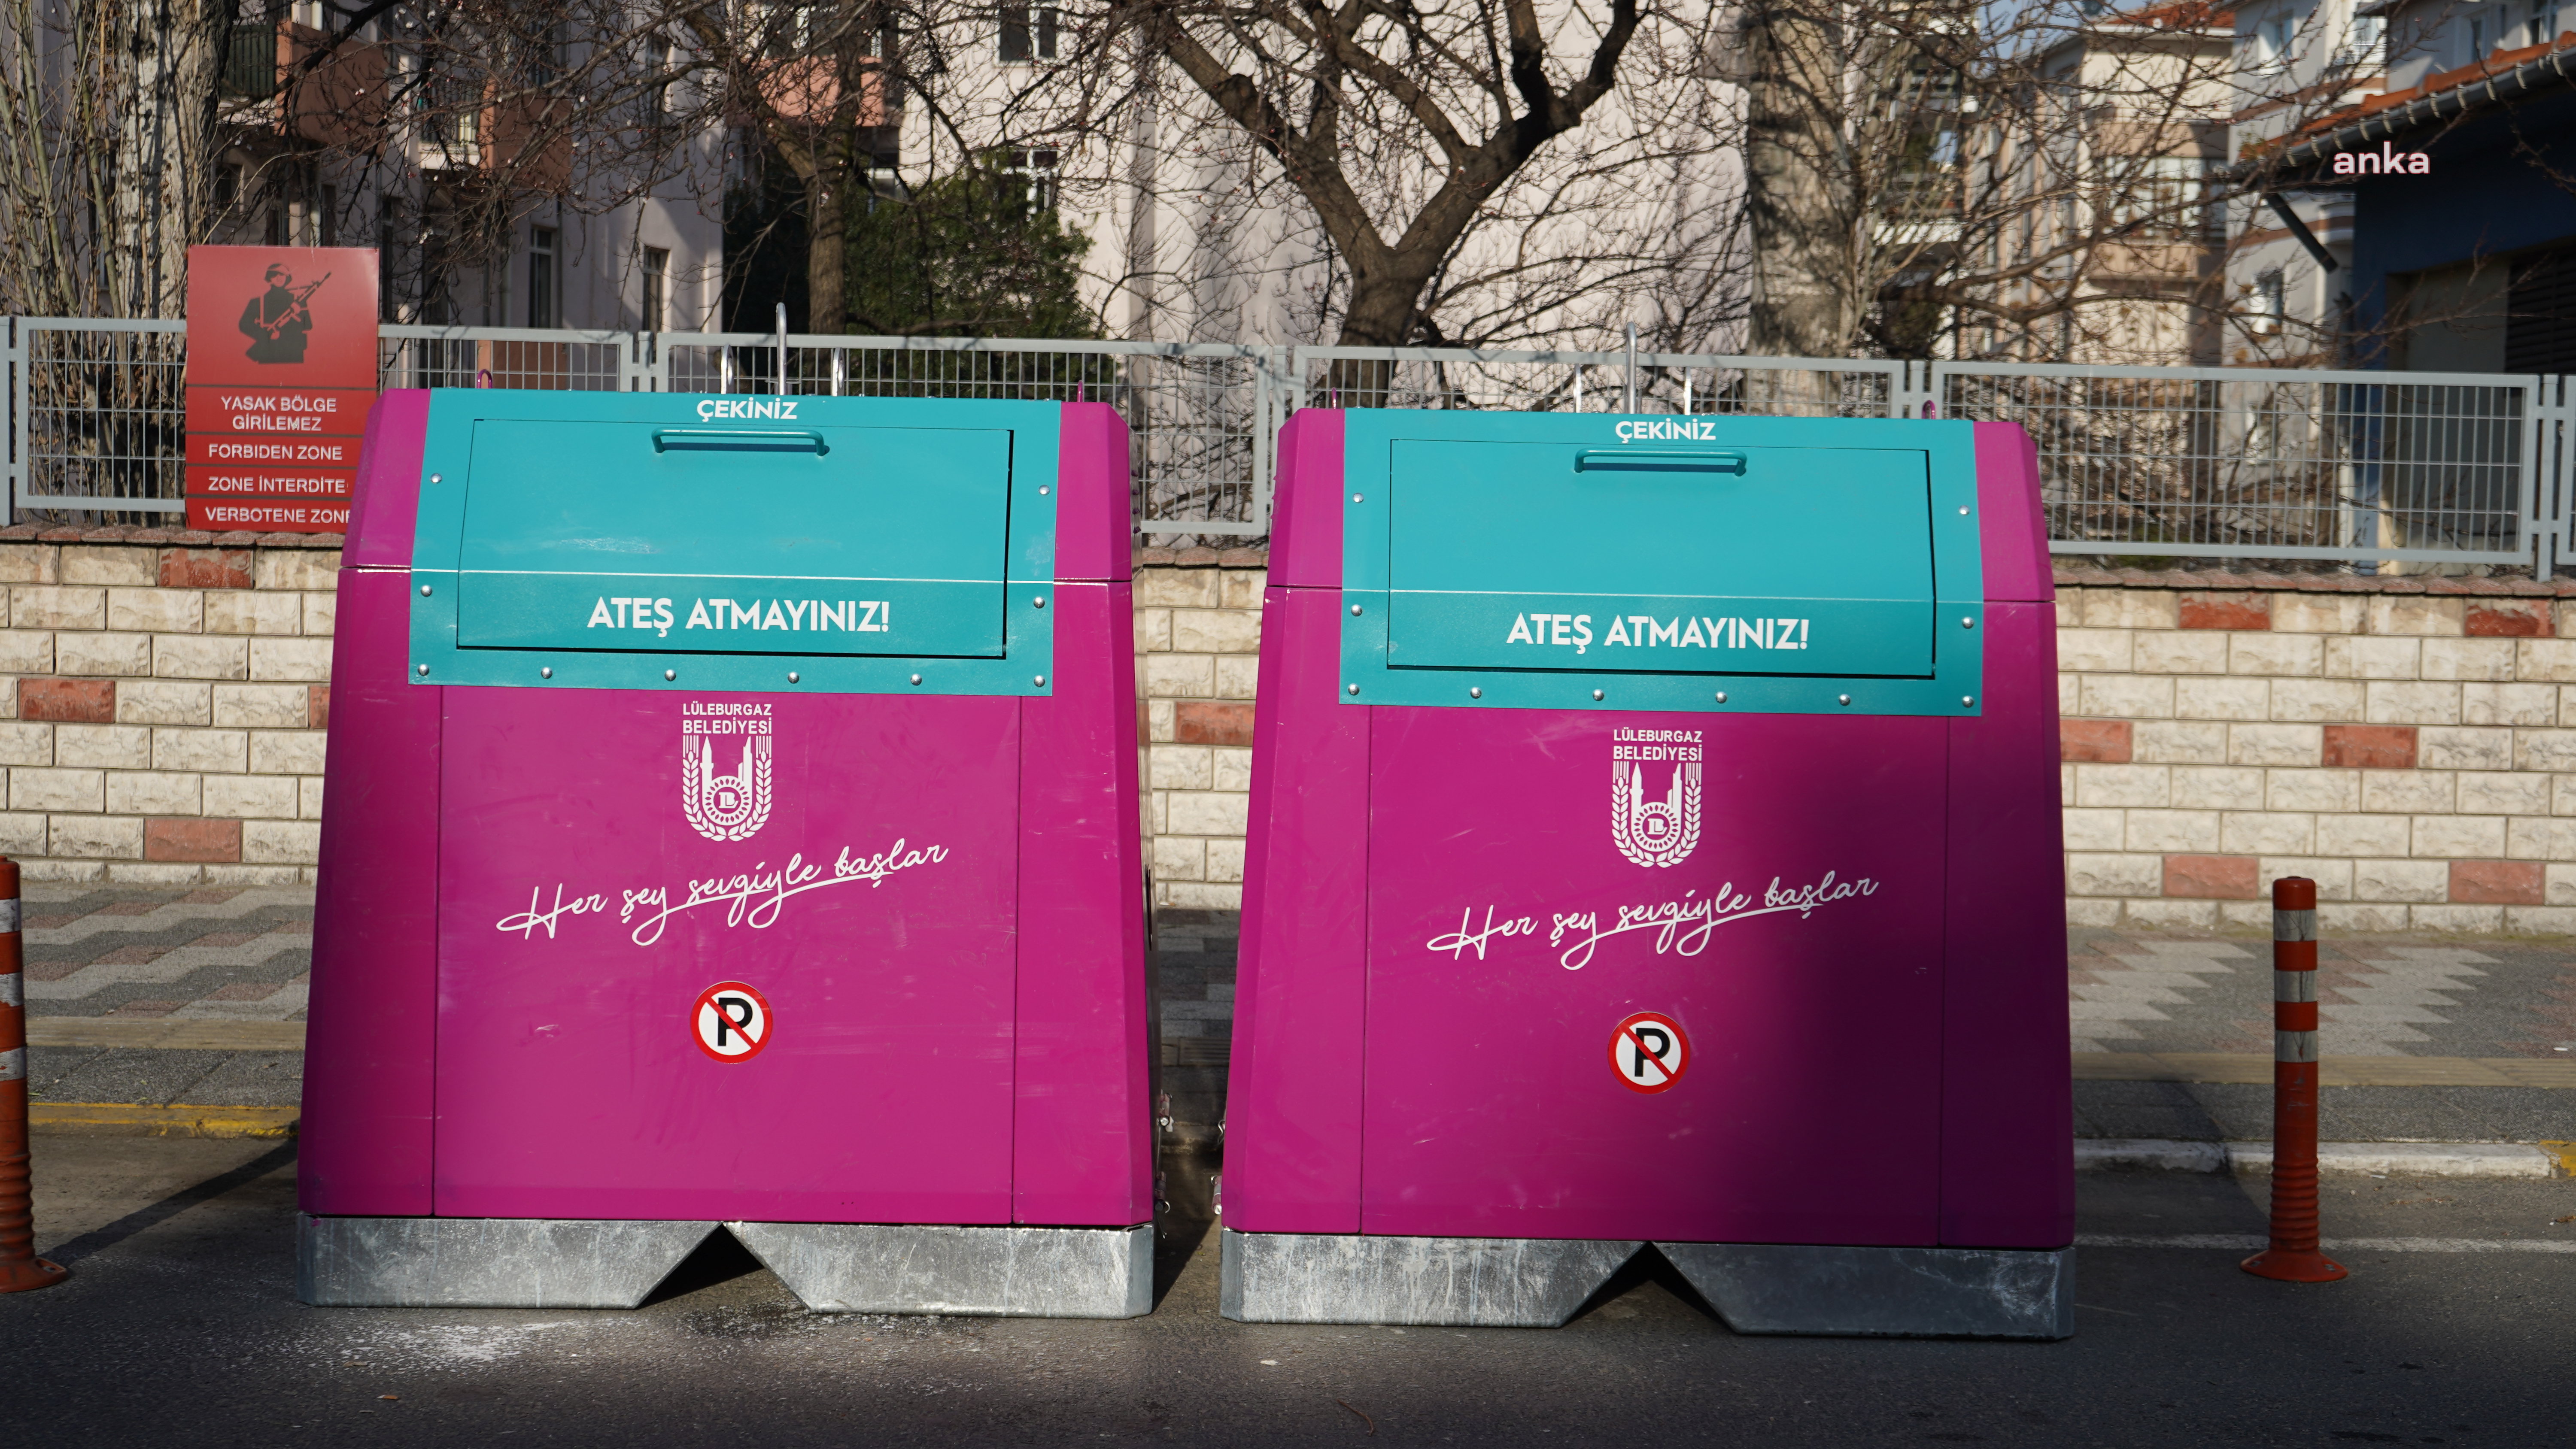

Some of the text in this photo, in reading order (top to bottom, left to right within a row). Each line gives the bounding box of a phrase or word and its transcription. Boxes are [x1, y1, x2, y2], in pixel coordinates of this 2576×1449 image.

[221, 394, 337, 412] YASAK BÖLGE
[696, 397, 798, 422] ÇEKİNİZ
[232, 413, 322, 431] GİRİLEMEZ
[1615, 418, 1716, 444] ÇEKİNİZ
[209, 443, 342, 460] FORBIDEN ZONE
[208, 475, 345, 493] ZONE İNTERDİTE
[205, 506, 306, 523] VERBOTENE
[587, 596, 889, 637] ATEŞ ATMAYINIZ!
[1506, 612, 1809, 655] ATEŞ ATMAYINIZ!
[683, 700, 772, 716] LÜLEBURGAZ
[683, 717, 772, 734] BELEDİYESİ
[1613, 727, 1702, 743] LÜLEBURGAZ
[1613, 743, 1702, 761] BELEDİYESİ
[496, 838, 949, 946] Her şey sevgiyle başlar
[1426, 870, 1879, 970] Her şey sevgiyle başlar
[717, 997, 753, 1046] P
[1634, 1028, 1671, 1077] P
